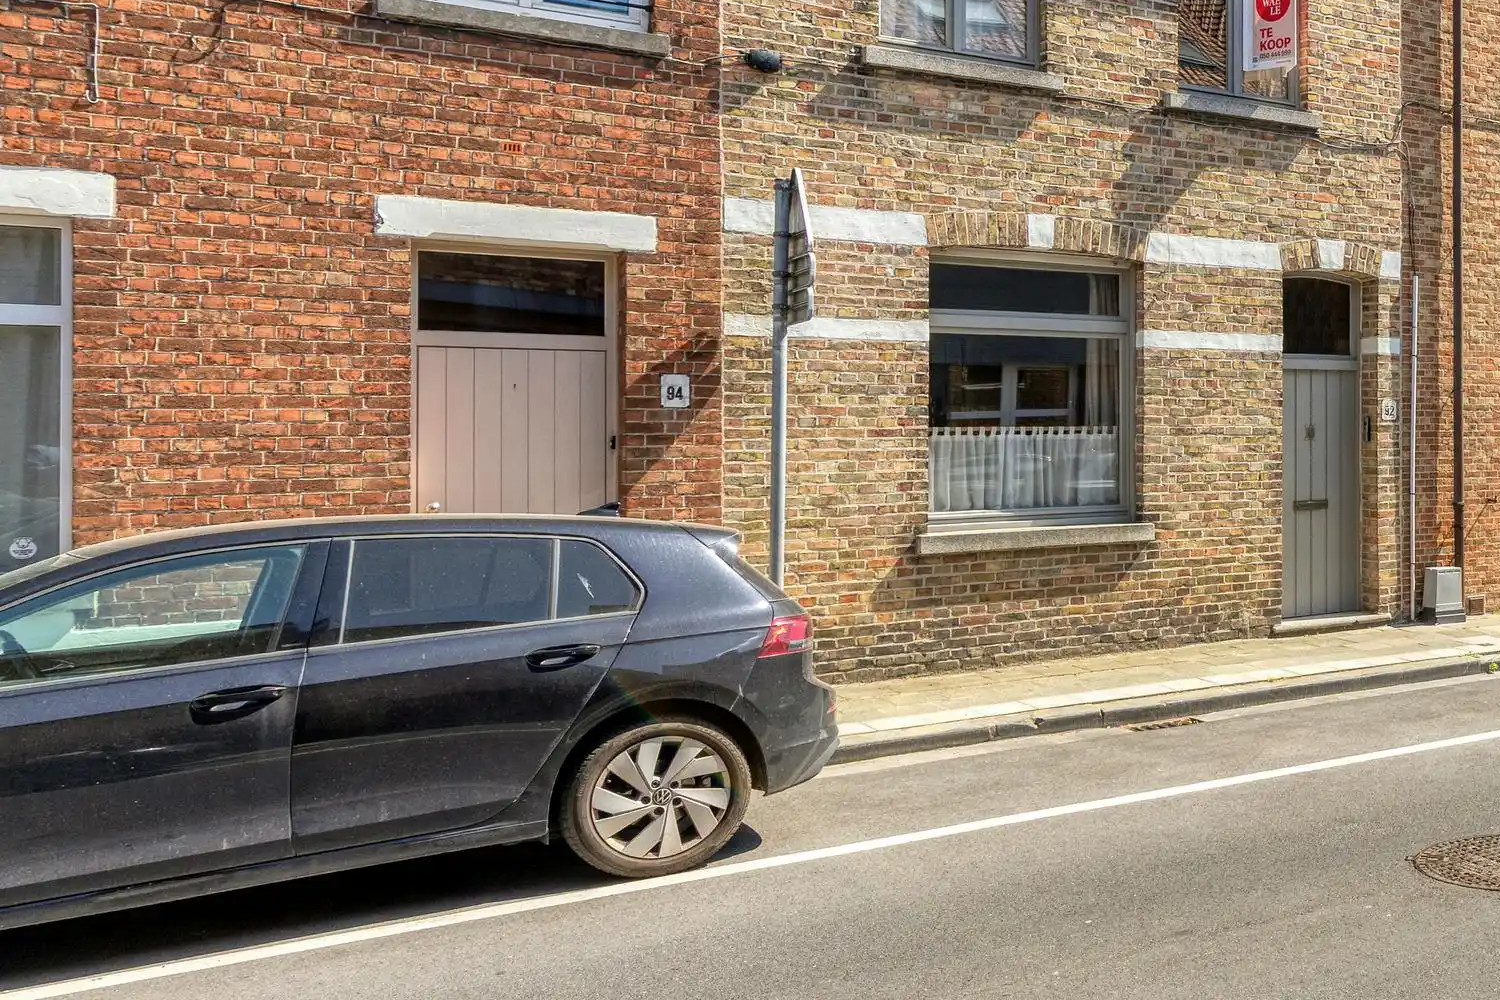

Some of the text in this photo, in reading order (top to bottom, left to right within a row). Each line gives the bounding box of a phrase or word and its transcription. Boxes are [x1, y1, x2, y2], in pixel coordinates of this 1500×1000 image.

[1270, 5, 1281, 16] LE
[1260, 27, 1273, 39] TE
[1260, 37, 1291, 51] KOOP
[666, 385, 684, 401] 94
[1385, 405, 1395, 416] 92
